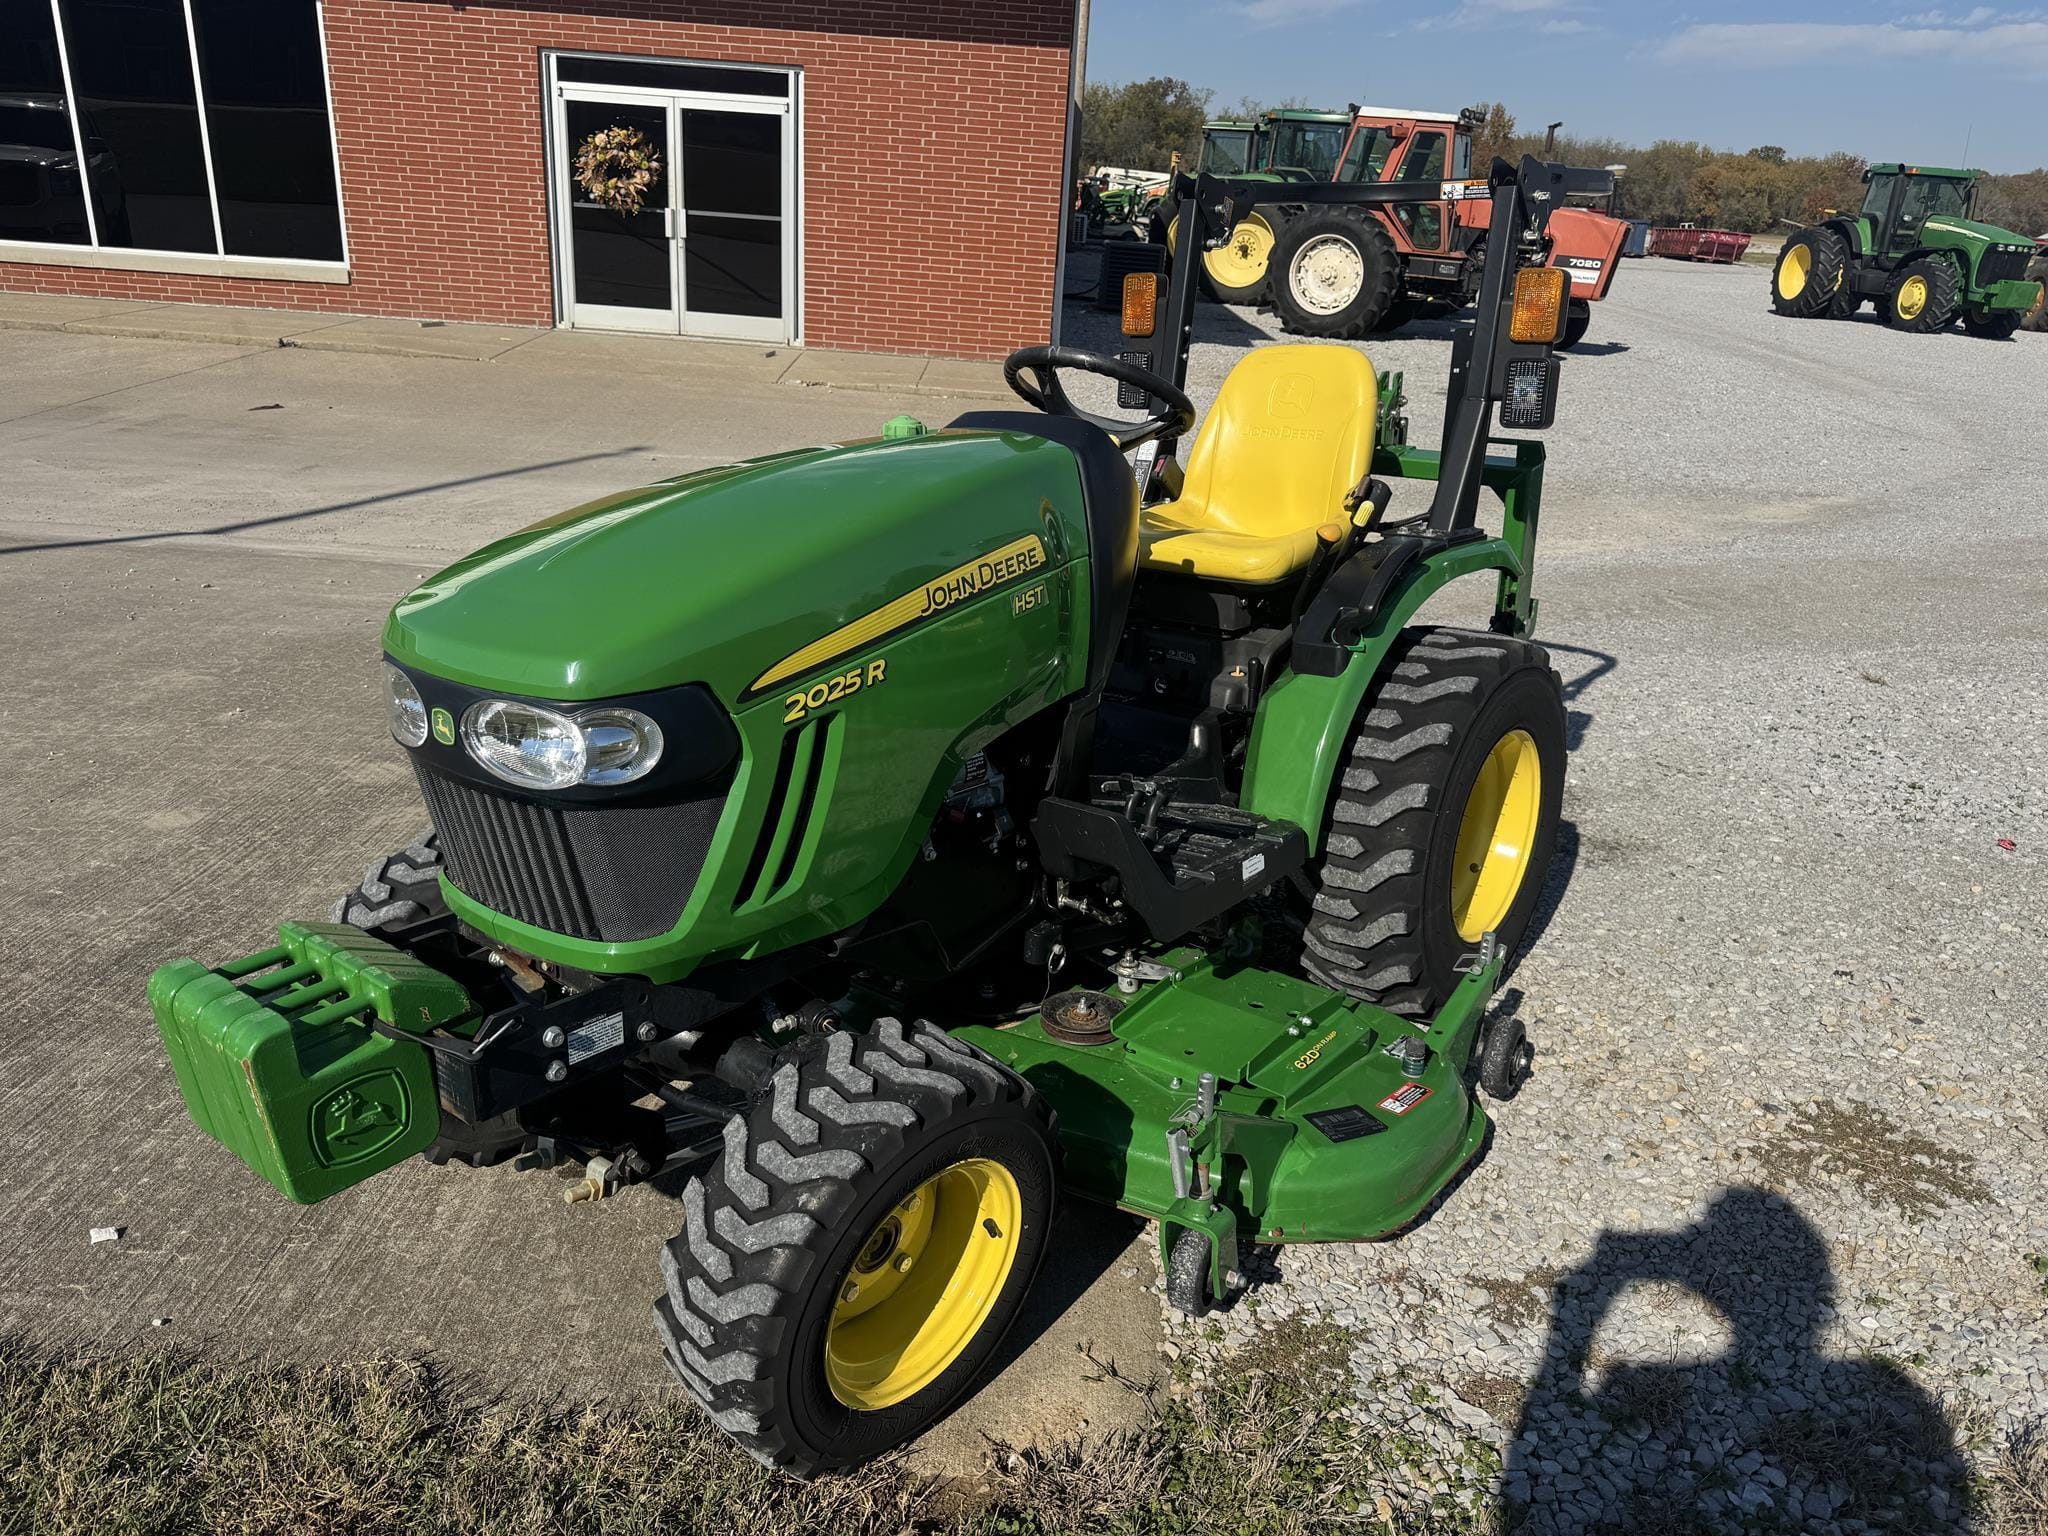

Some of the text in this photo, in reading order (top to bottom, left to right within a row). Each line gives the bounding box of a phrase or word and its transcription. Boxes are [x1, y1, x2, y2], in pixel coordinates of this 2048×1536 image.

[1569, 258, 1601, 268] 7020
[920, 546, 1039, 616] JOHN DEERE
[1014, 583, 1044, 615] HST
[783, 668, 863, 724] 2025
[1294, 1049, 1320, 1069] 62D
